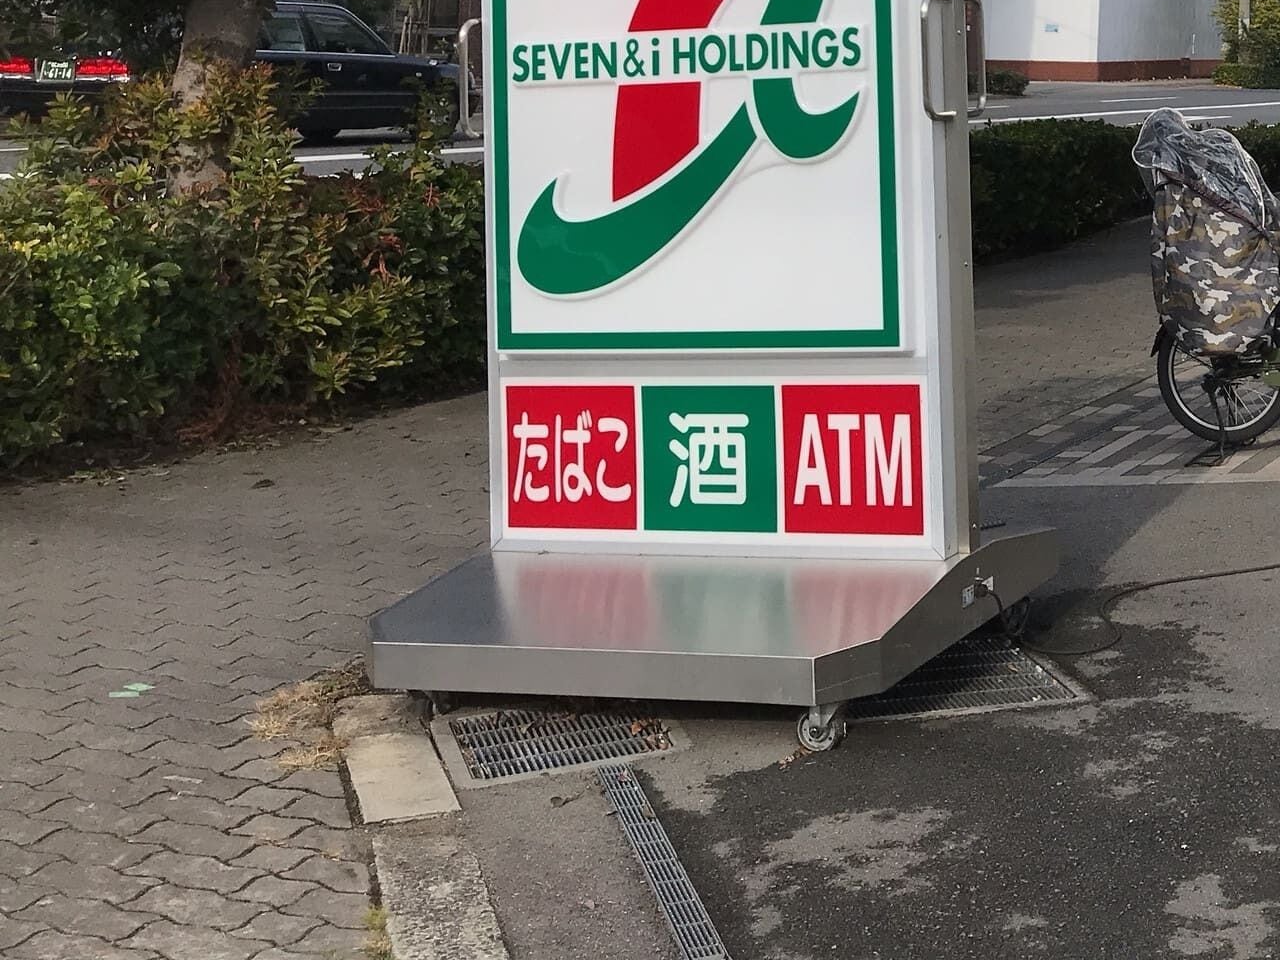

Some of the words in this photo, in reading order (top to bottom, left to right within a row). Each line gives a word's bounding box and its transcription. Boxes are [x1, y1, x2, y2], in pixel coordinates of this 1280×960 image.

[672, 26, 862, 75] HOLDINGS
[512, 411, 632, 503] たばこ
[668, 411, 749, 508] 酒
[793, 413, 913, 507] ATM
